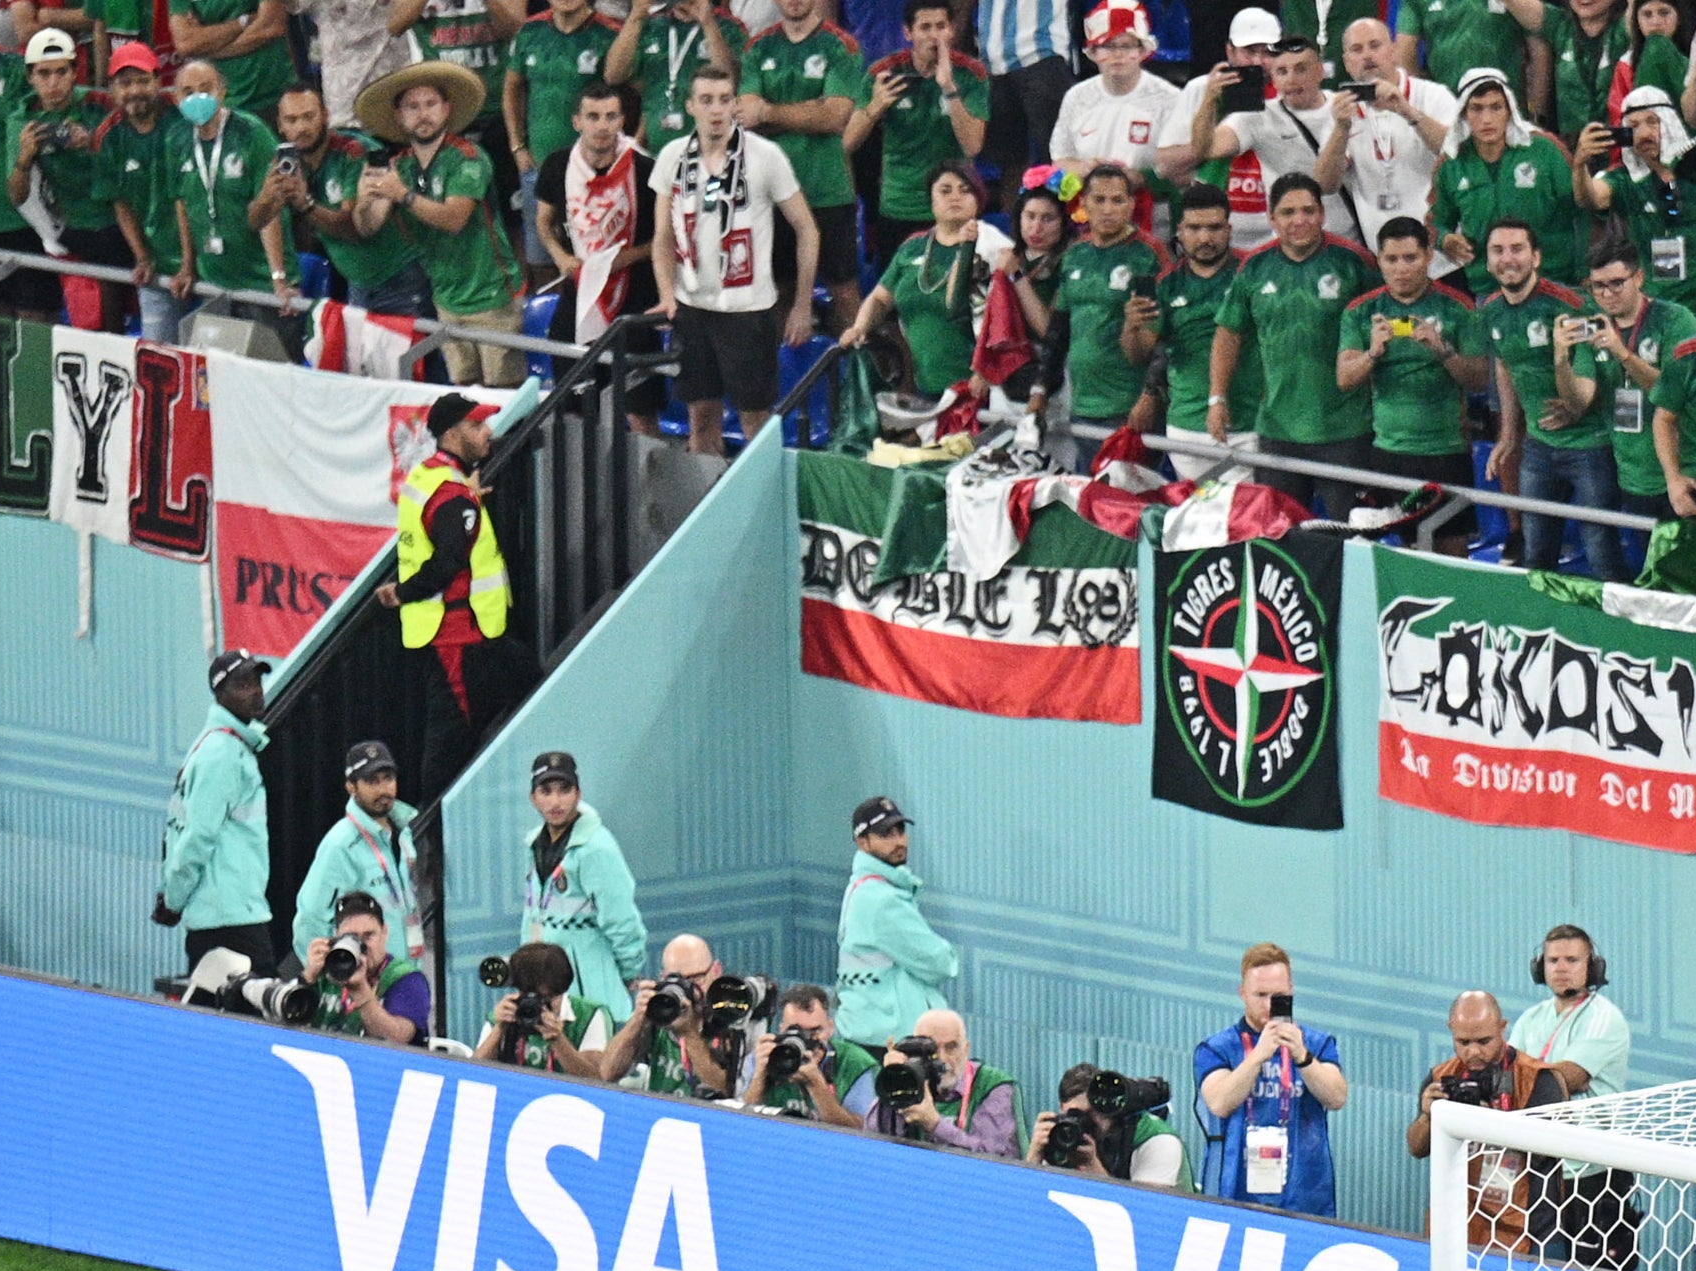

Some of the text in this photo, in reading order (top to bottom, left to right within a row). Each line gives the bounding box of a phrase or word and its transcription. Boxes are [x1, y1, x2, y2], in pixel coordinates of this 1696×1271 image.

[1173, 556, 1319, 663] TIGRES MÉXICO
[1598, 769, 1652, 813] Del
